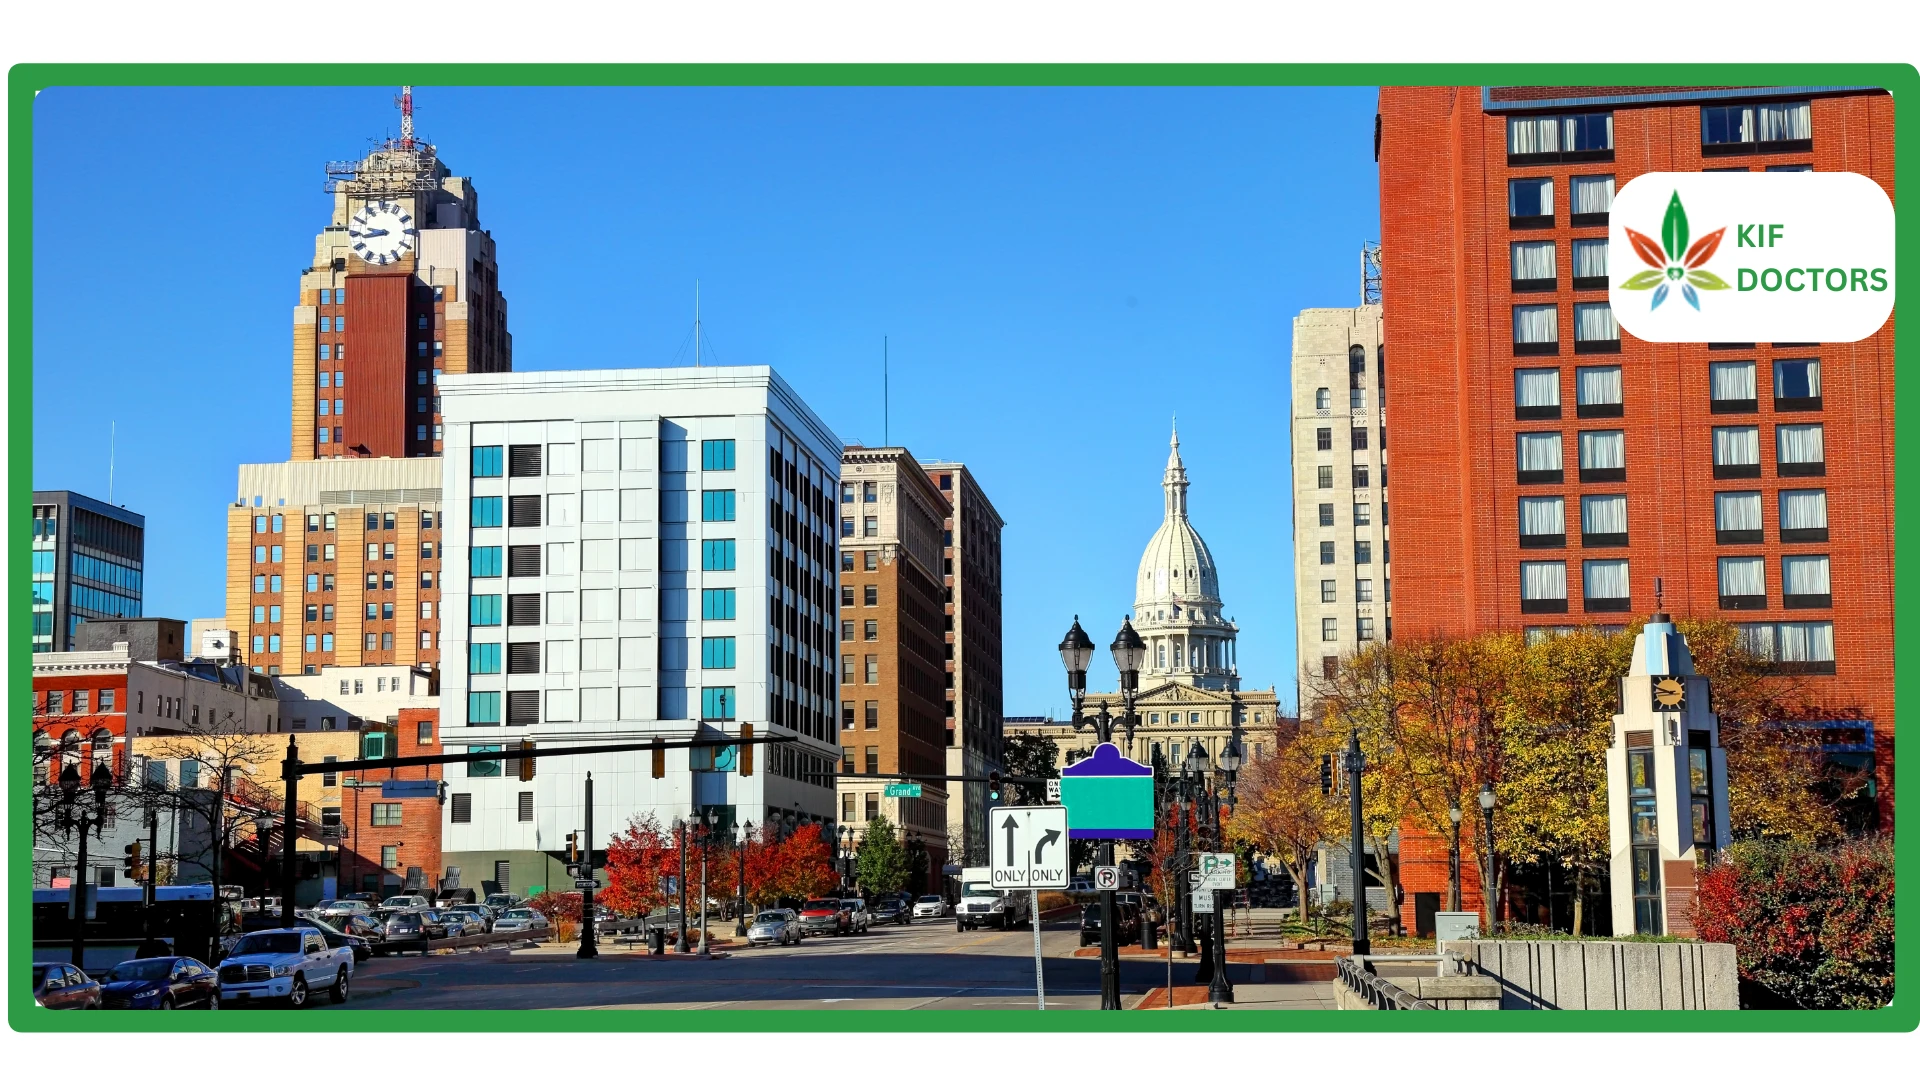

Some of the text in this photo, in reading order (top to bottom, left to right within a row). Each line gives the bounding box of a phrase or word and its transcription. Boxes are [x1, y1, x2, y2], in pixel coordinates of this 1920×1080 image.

[890, 786, 911, 796] Grand
[995, 869, 1026, 882] ONLY
[1032, 869, 1063, 881] ONLY
